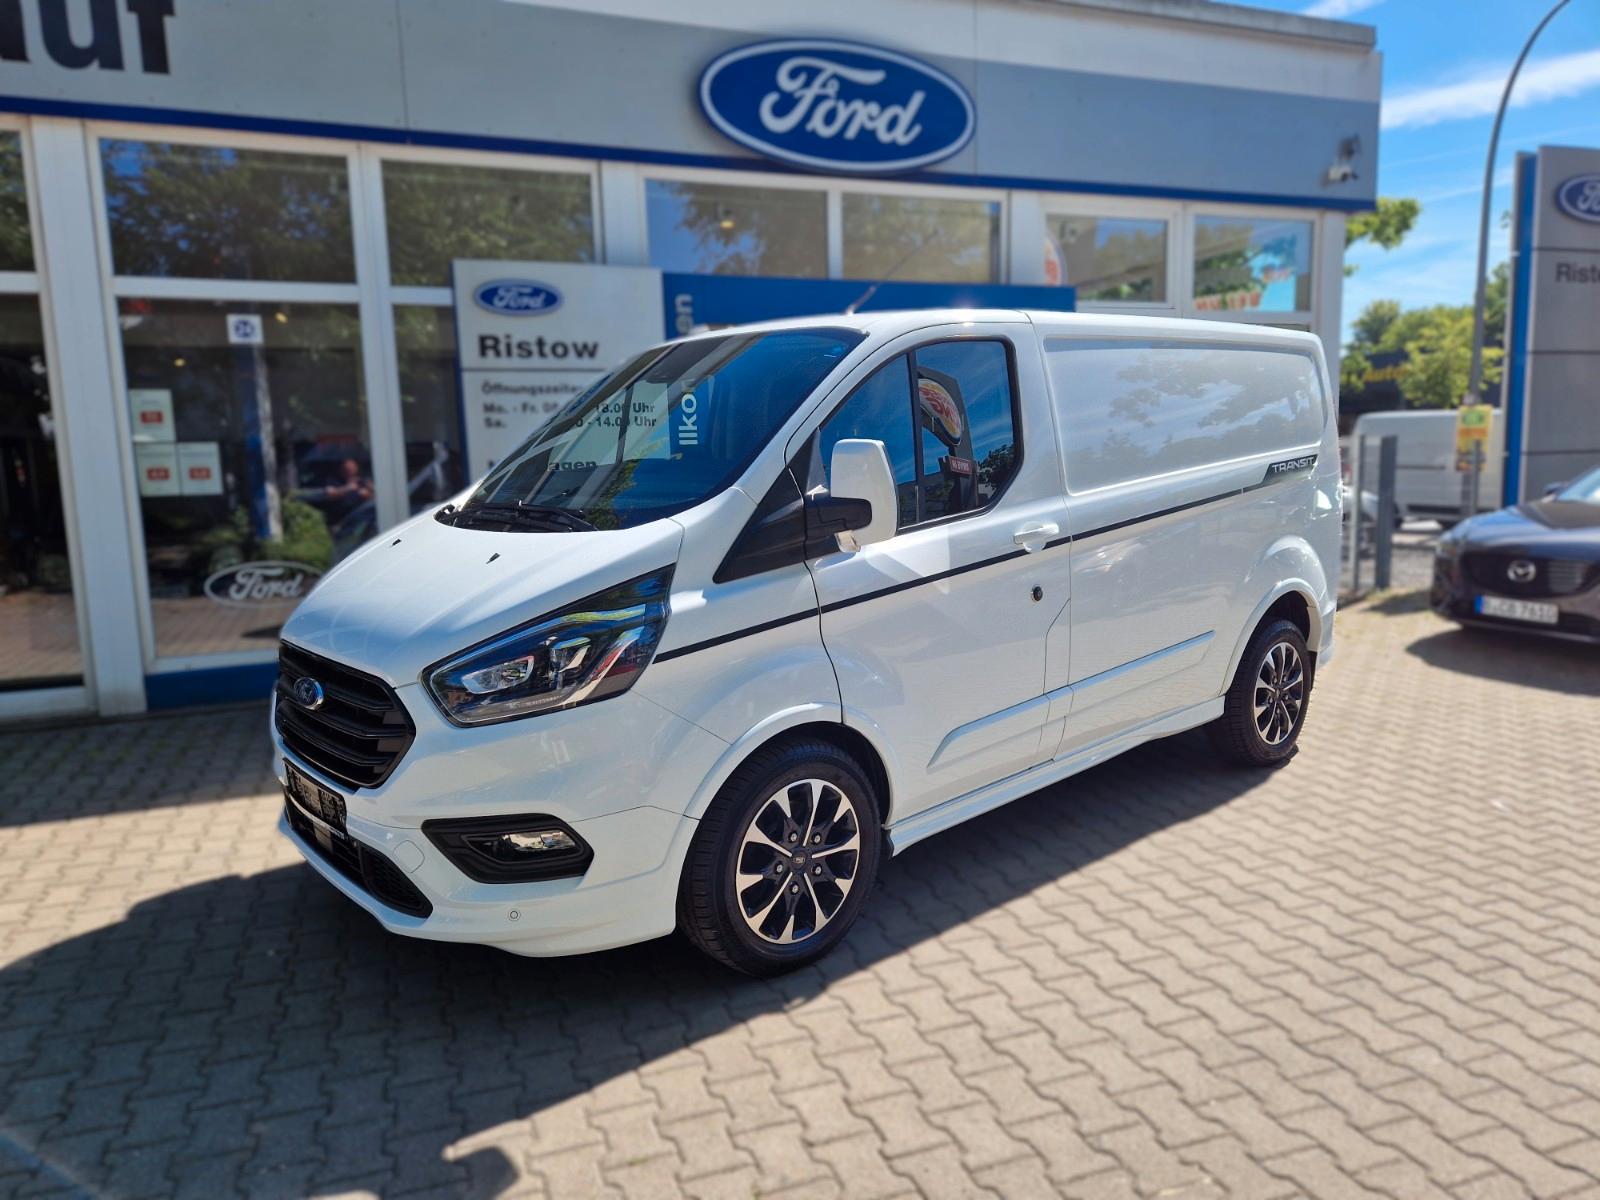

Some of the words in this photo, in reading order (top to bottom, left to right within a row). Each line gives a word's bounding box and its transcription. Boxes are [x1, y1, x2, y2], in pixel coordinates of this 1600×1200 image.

[759, 57, 926, 146] Ford
[1555, 262, 1600, 283] Rist
[493, 287, 546, 309] Ford
[479, 334, 599, 359] Ristow
[633, 403, 655, 413] Uhr
[596, 416, 630, 427] 14.0
[635, 416, 657, 427] Uhr
[1271, 456, 1314, 473] TRANSIT
[229, 566, 304, 600] Ford
